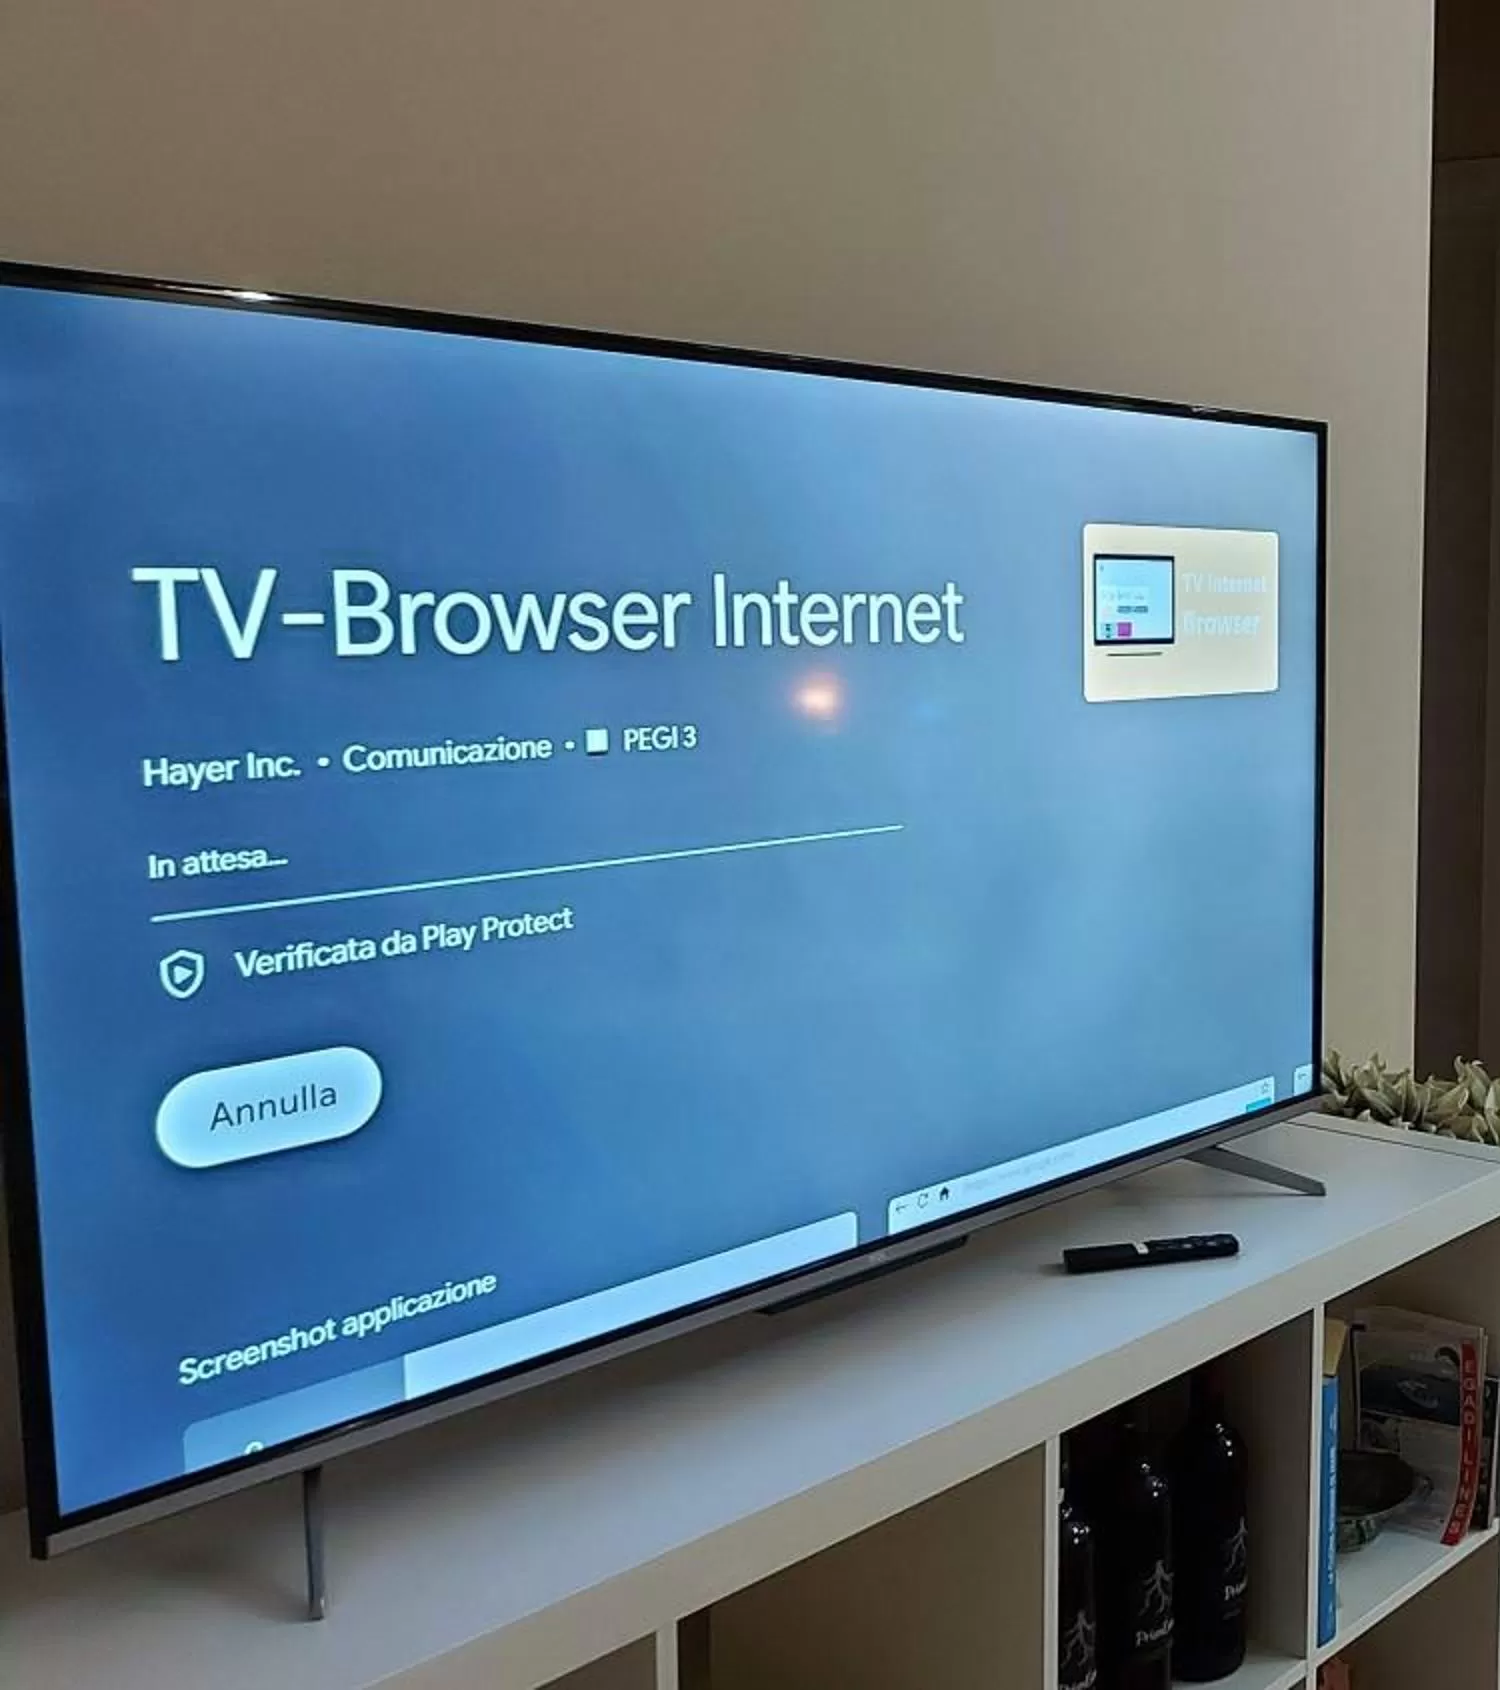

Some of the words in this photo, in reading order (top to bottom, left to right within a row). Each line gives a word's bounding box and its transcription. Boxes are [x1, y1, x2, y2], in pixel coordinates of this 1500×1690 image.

[1182, 571, 1202, 593] TV
[1207, 572, 1266, 593] Internet
[132, 568, 692, 662] TV-Browser
[714, 573, 966, 648] Internet
[1183, 612, 1259, 636] Browser
[343, 735, 554, 774] Comunicazione
[623, 727, 679, 752] PEGI
[683, 726, 698, 750] 3
[143, 757, 241, 792] Hayer
[247, 752, 302, 781] Inc.
[148, 856, 177, 880] In
[235, 938, 378, 979] Verificata
[383, 930, 417, 958] da
[422, 922, 478, 955] Play
[482, 906, 575, 942] Protect
[210, 1083, 338, 1133] Annulla
[178, 1318, 338, 1386] Screenshot
[341, 1272, 498, 1339] applicazione
